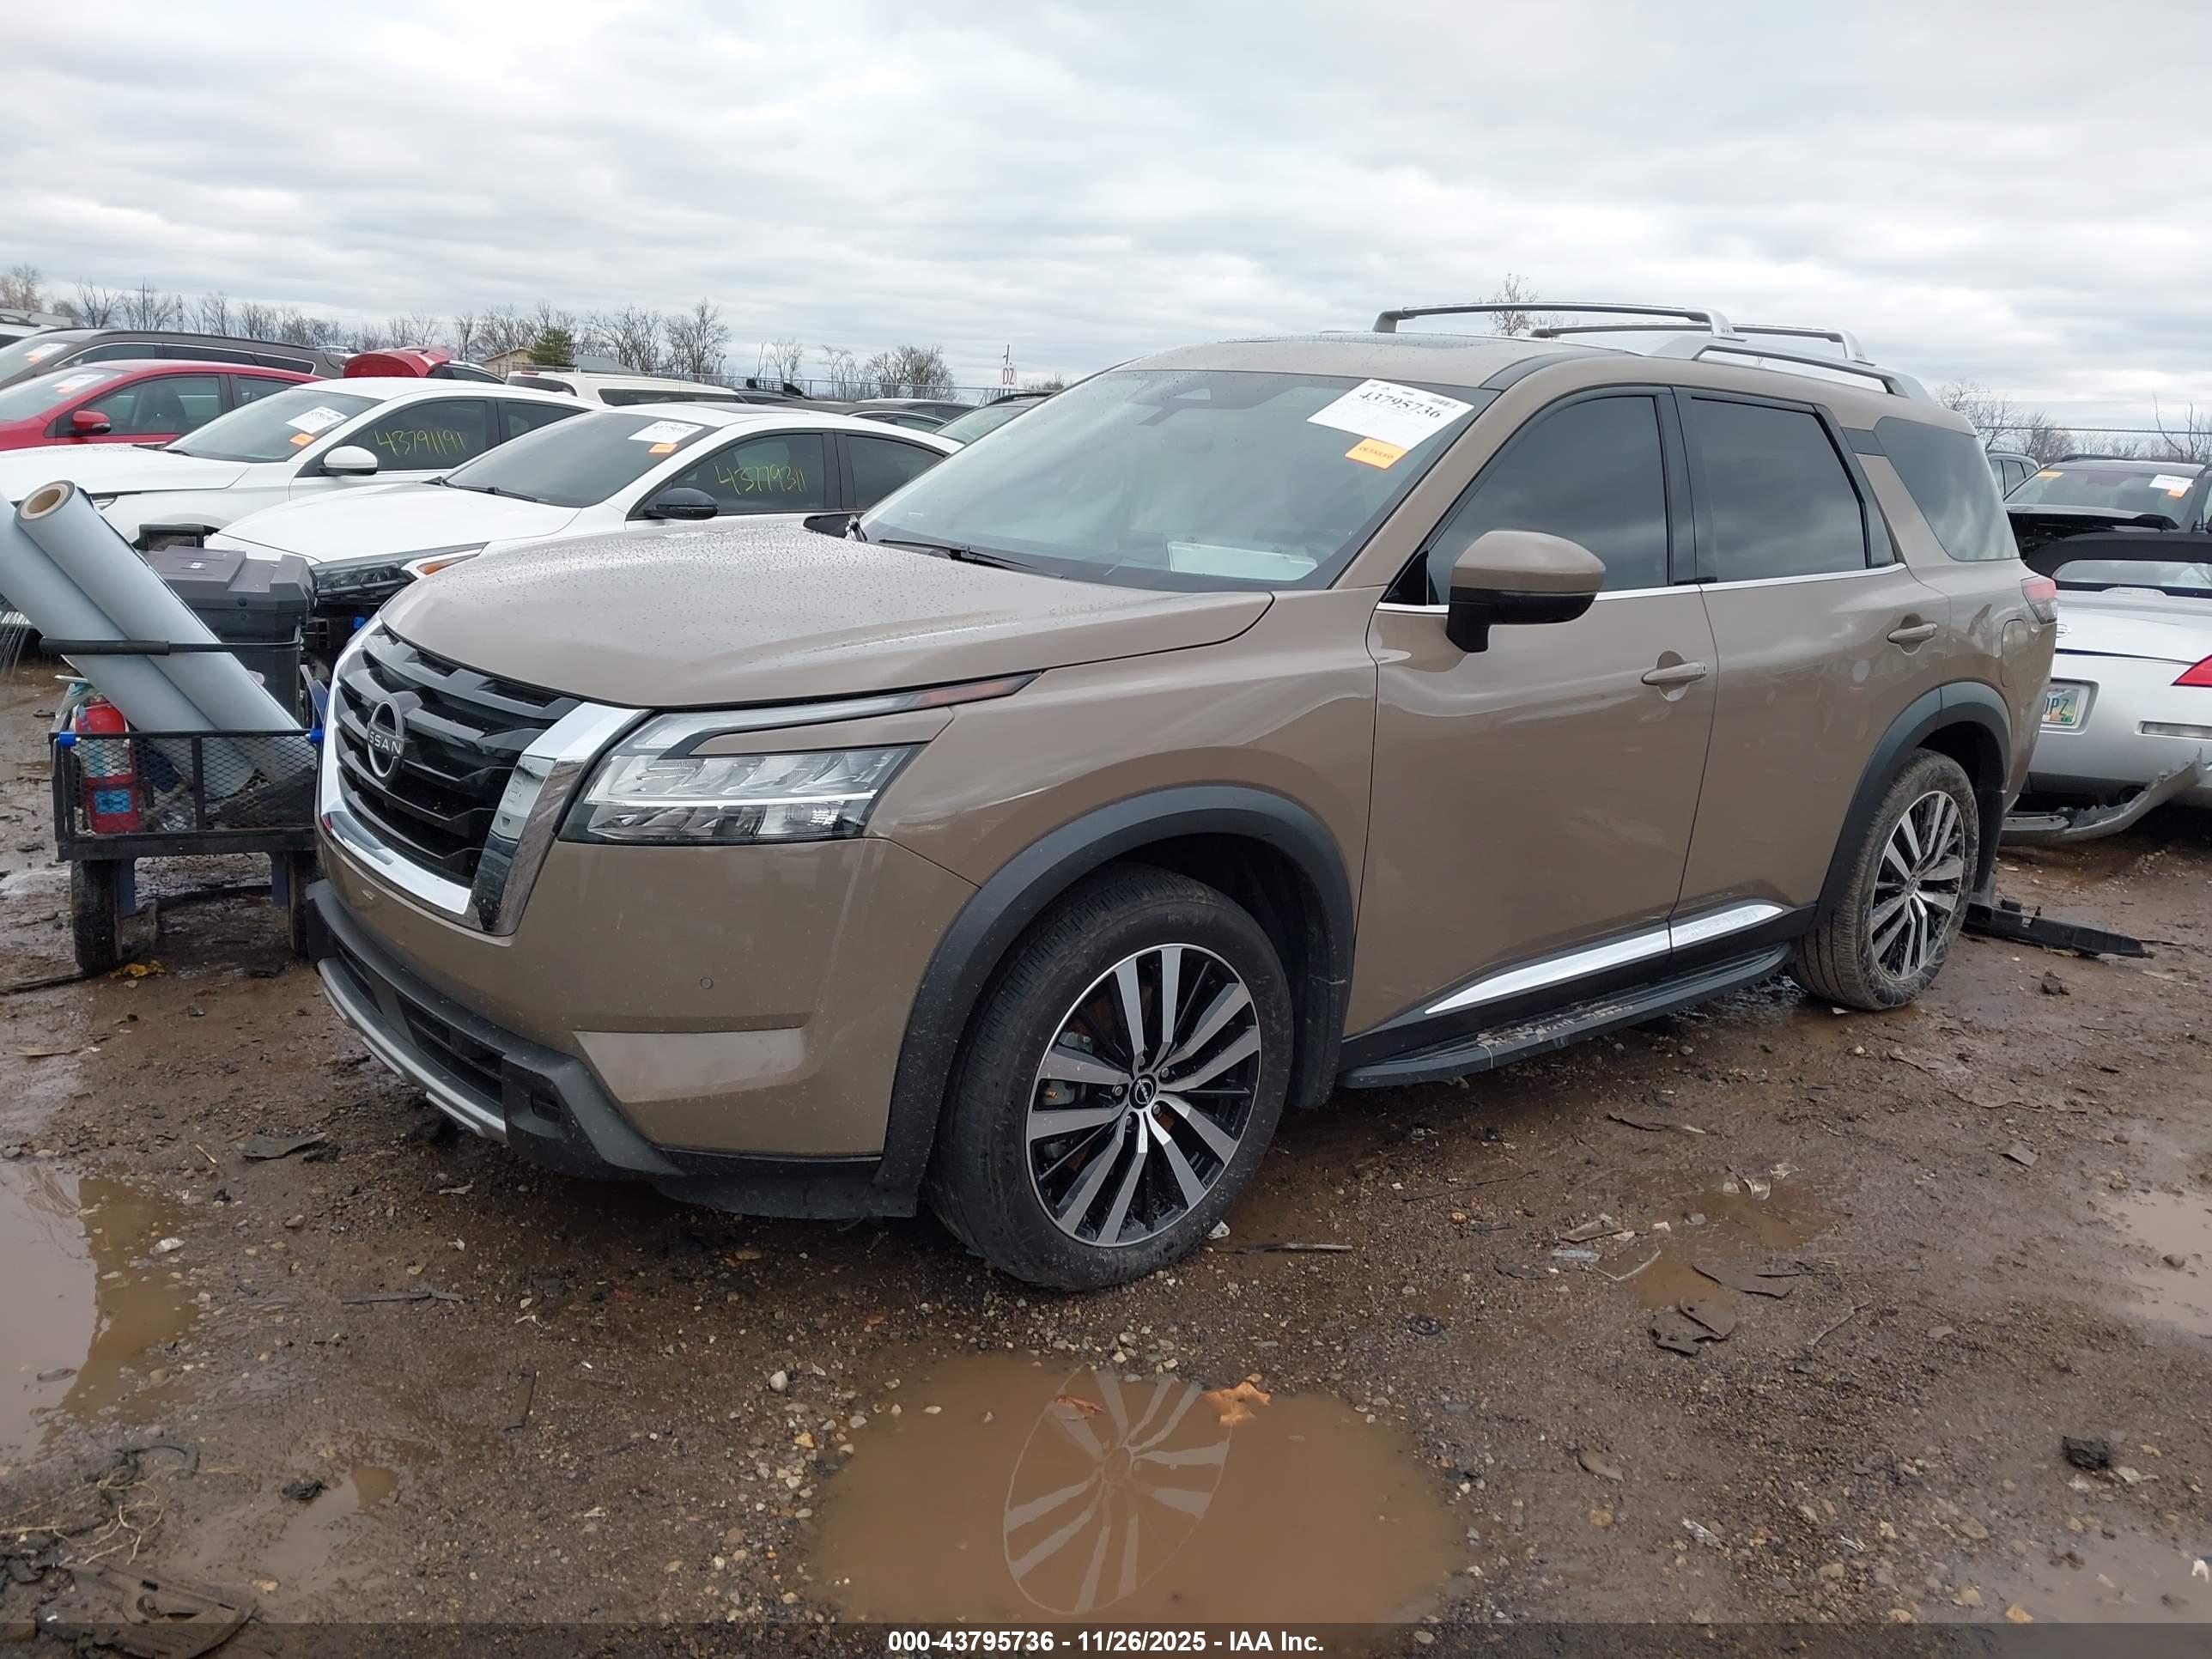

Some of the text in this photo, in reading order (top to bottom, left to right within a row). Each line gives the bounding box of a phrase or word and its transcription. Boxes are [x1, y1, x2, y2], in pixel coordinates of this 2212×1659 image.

[1002, 368, 1015, 386] DZ
[1359, 392, 1443, 418] 43795736
[374, 429, 466, 457] 43791191
[714, 464, 807, 495] 43779311
